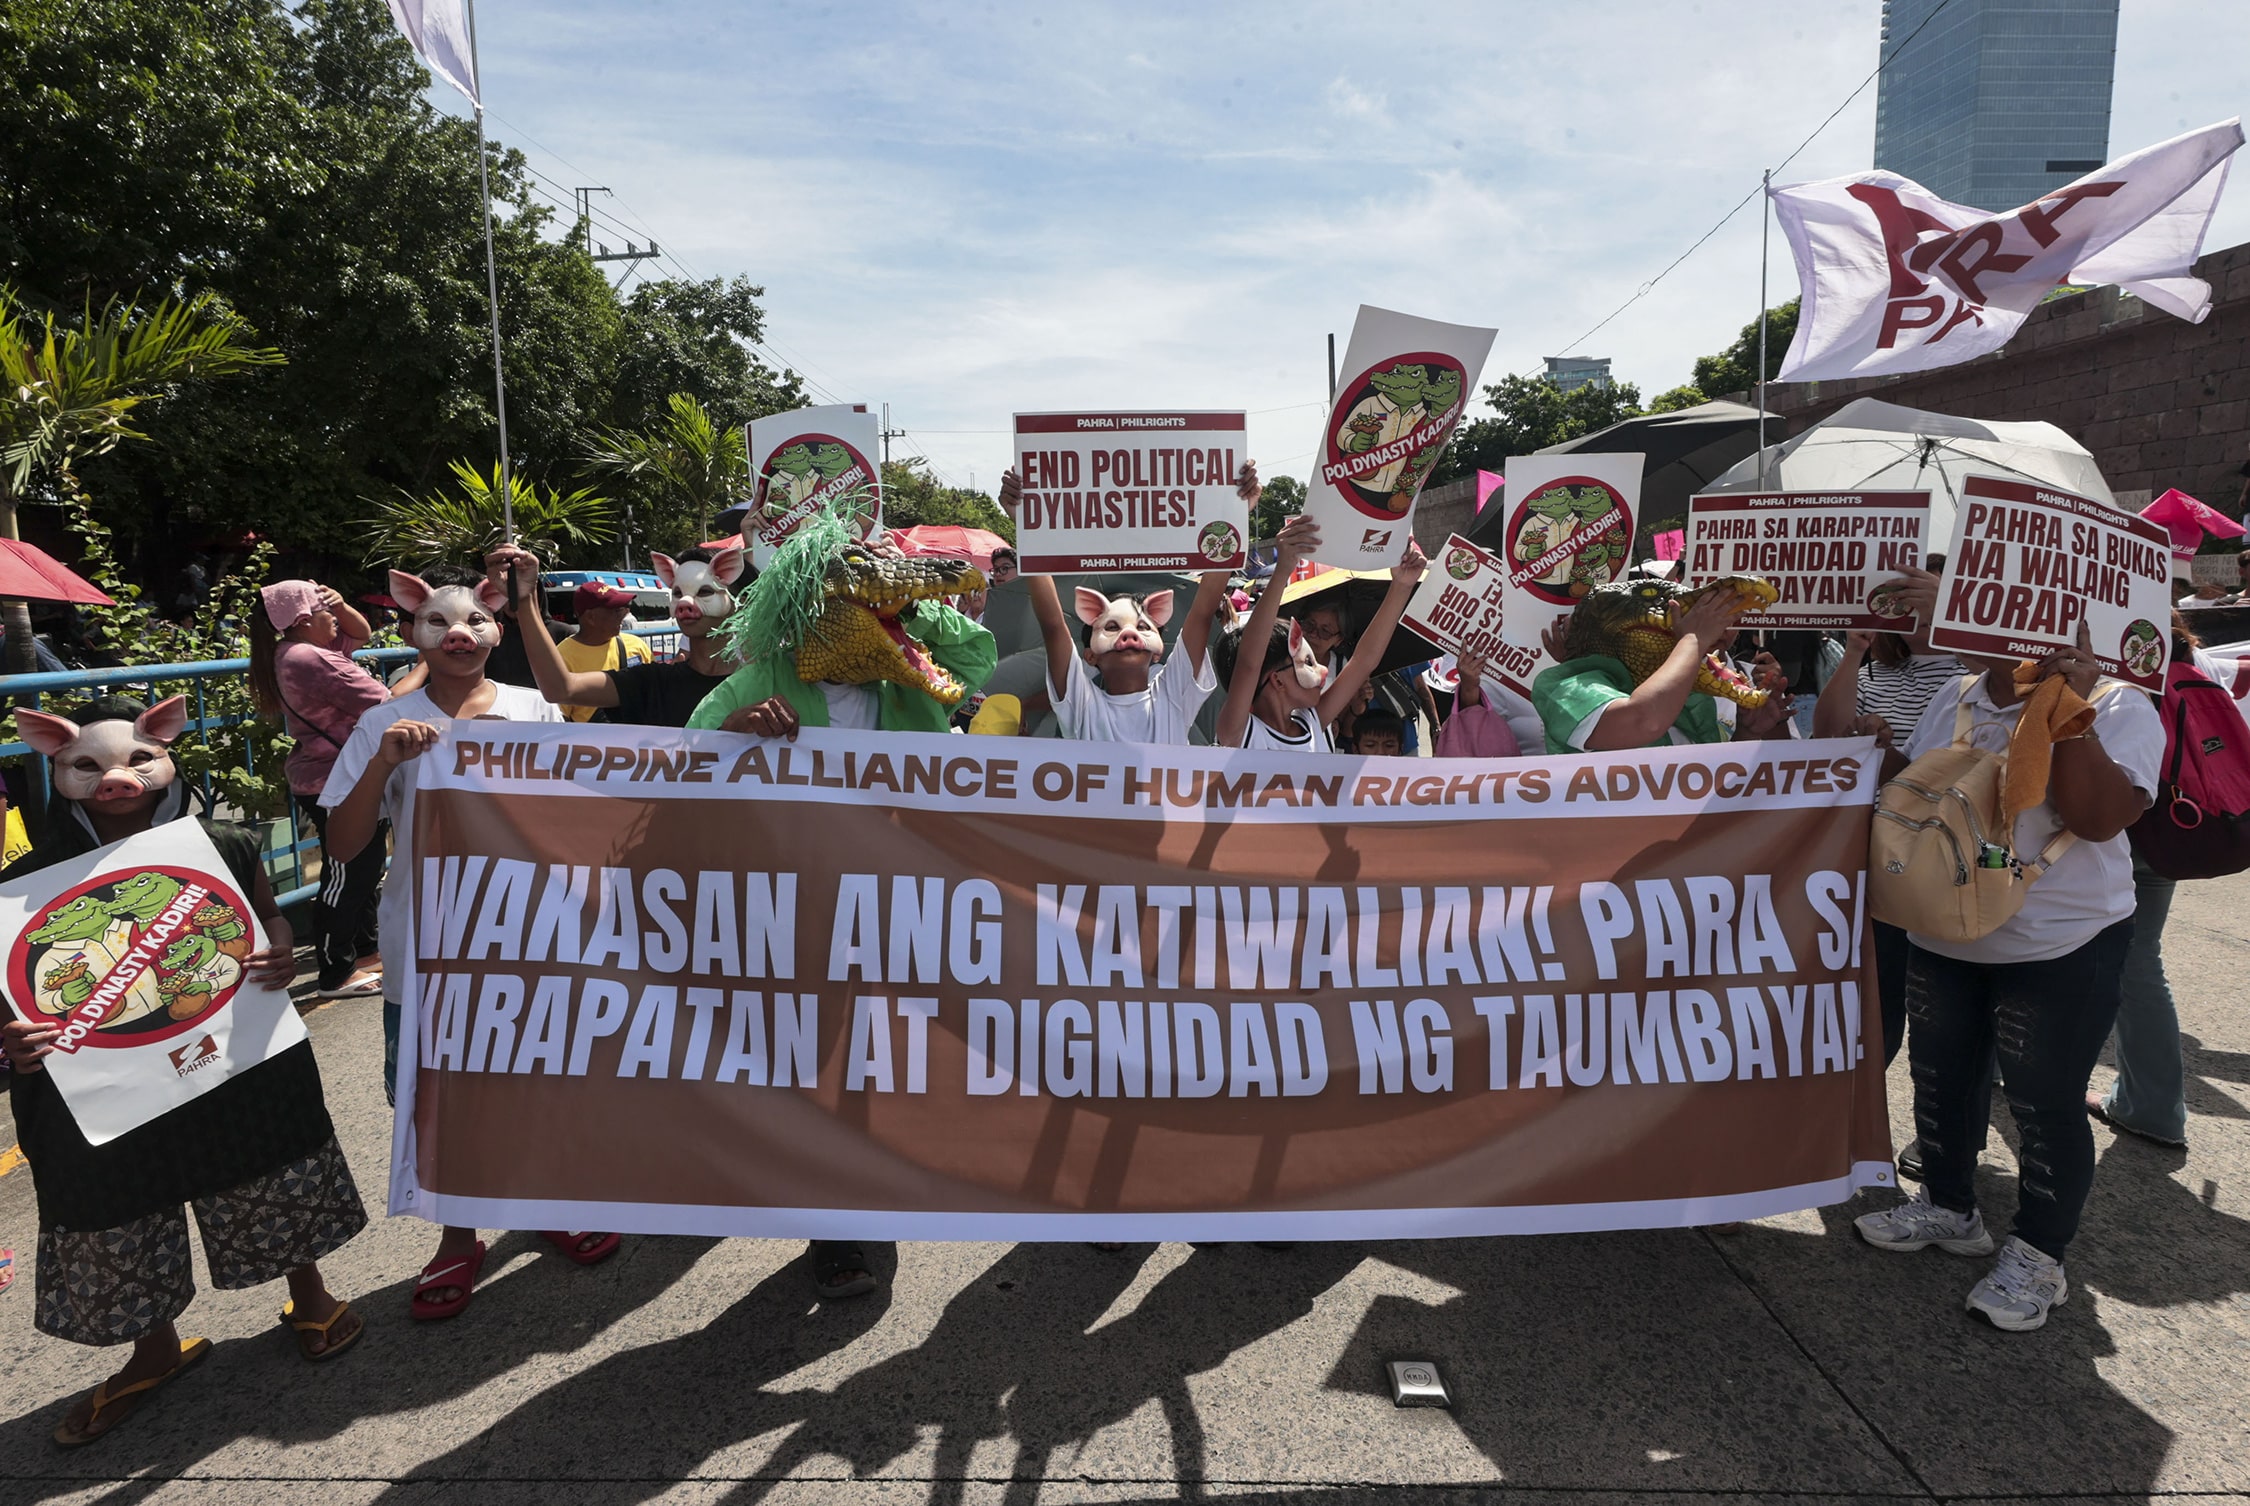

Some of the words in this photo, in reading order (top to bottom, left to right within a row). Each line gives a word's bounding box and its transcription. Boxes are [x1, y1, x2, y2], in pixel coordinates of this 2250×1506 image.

[1077, 418, 1114, 428] PAHRA
[1121, 417, 1186, 427] PHILRIGHTS
[1021, 450, 1080, 490] END
[1092, 448, 1239, 488] POLITICAL
[1325, 464, 1354, 483] POL
[1351, 439, 1416, 475] DYNASTY
[1023, 489, 1196, 530] DYNASTIES!
[1748, 497, 1786, 506] PAHRA
[1793, 496, 1863, 506] PHILRIGHTS
[2036, 491, 2073, 509] PAHRA
[2078, 502, 2130, 528] PHILRIGHTS
[760, 522, 782, 543] POL
[1510, 567, 1534, 586] POL
[1530, 537, 1579, 575] DYNASTY
[1578, 508, 1623, 546] KADIRI!
[1695, 518, 1757, 540] PAHRA
[1763, 517, 1789, 539] SA
[1795, 516, 1921, 539] KARAPATAN
[1964, 502, 2063, 550] PAHRA
[2071, 521, 2099, 561] SA
[2106, 531, 2167, 584] BUKAS
[1080, 558, 1117, 568] PAHRA
[1124, 557, 1188, 567] PHILRIGHTS
[1359, 545, 1385, 553] PAHRA
[1692, 543, 1725, 572] AT
[1732, 541, 1867, 572] DIGNIDAD
[1876, 541, 1919, 572] NG
[1955, 538, 2006, 581] NA
[2020, 545, 2130, 609] WALANG
[1438, 583, 1481, 619] OUR
[1740, 616, 1777, 625] PAHRA
[1783, 616, 1853, 626] PHILRIGHTS
[1427, 604, 1535, 679] CORRUPTION
[452, 740, 719, 783] PHILIPPINE
[726, 745, 1018, 799] ALLIANCE
[1032, 762, 1109, 802] OF
[1123, 766, 1344, 807] HUMAN
[1353, 769, 1551, 806] RIGHTS
[1564, 757, 1861, 802] ADVOCATES
[418, 855, 798, 980] WAKASAN
[827, 873, 1003, 985] ANG
[1036, 883, 1566, 990] KATIWALIAN!
[1578, 873, 1797, 980] PARA
[54, 1017, 95, 1050] POL
[81, 947, 152, 1020] DYNASTY
[140, 883, 209, 950] KADIRI!
[177, 1053, 222, 1078] PAHRA
[845, 996, 938, 1094] AT
[966, 998, 1330, 1098] DIGNIDAD
[1348, 998, 1454, 1095] NG
